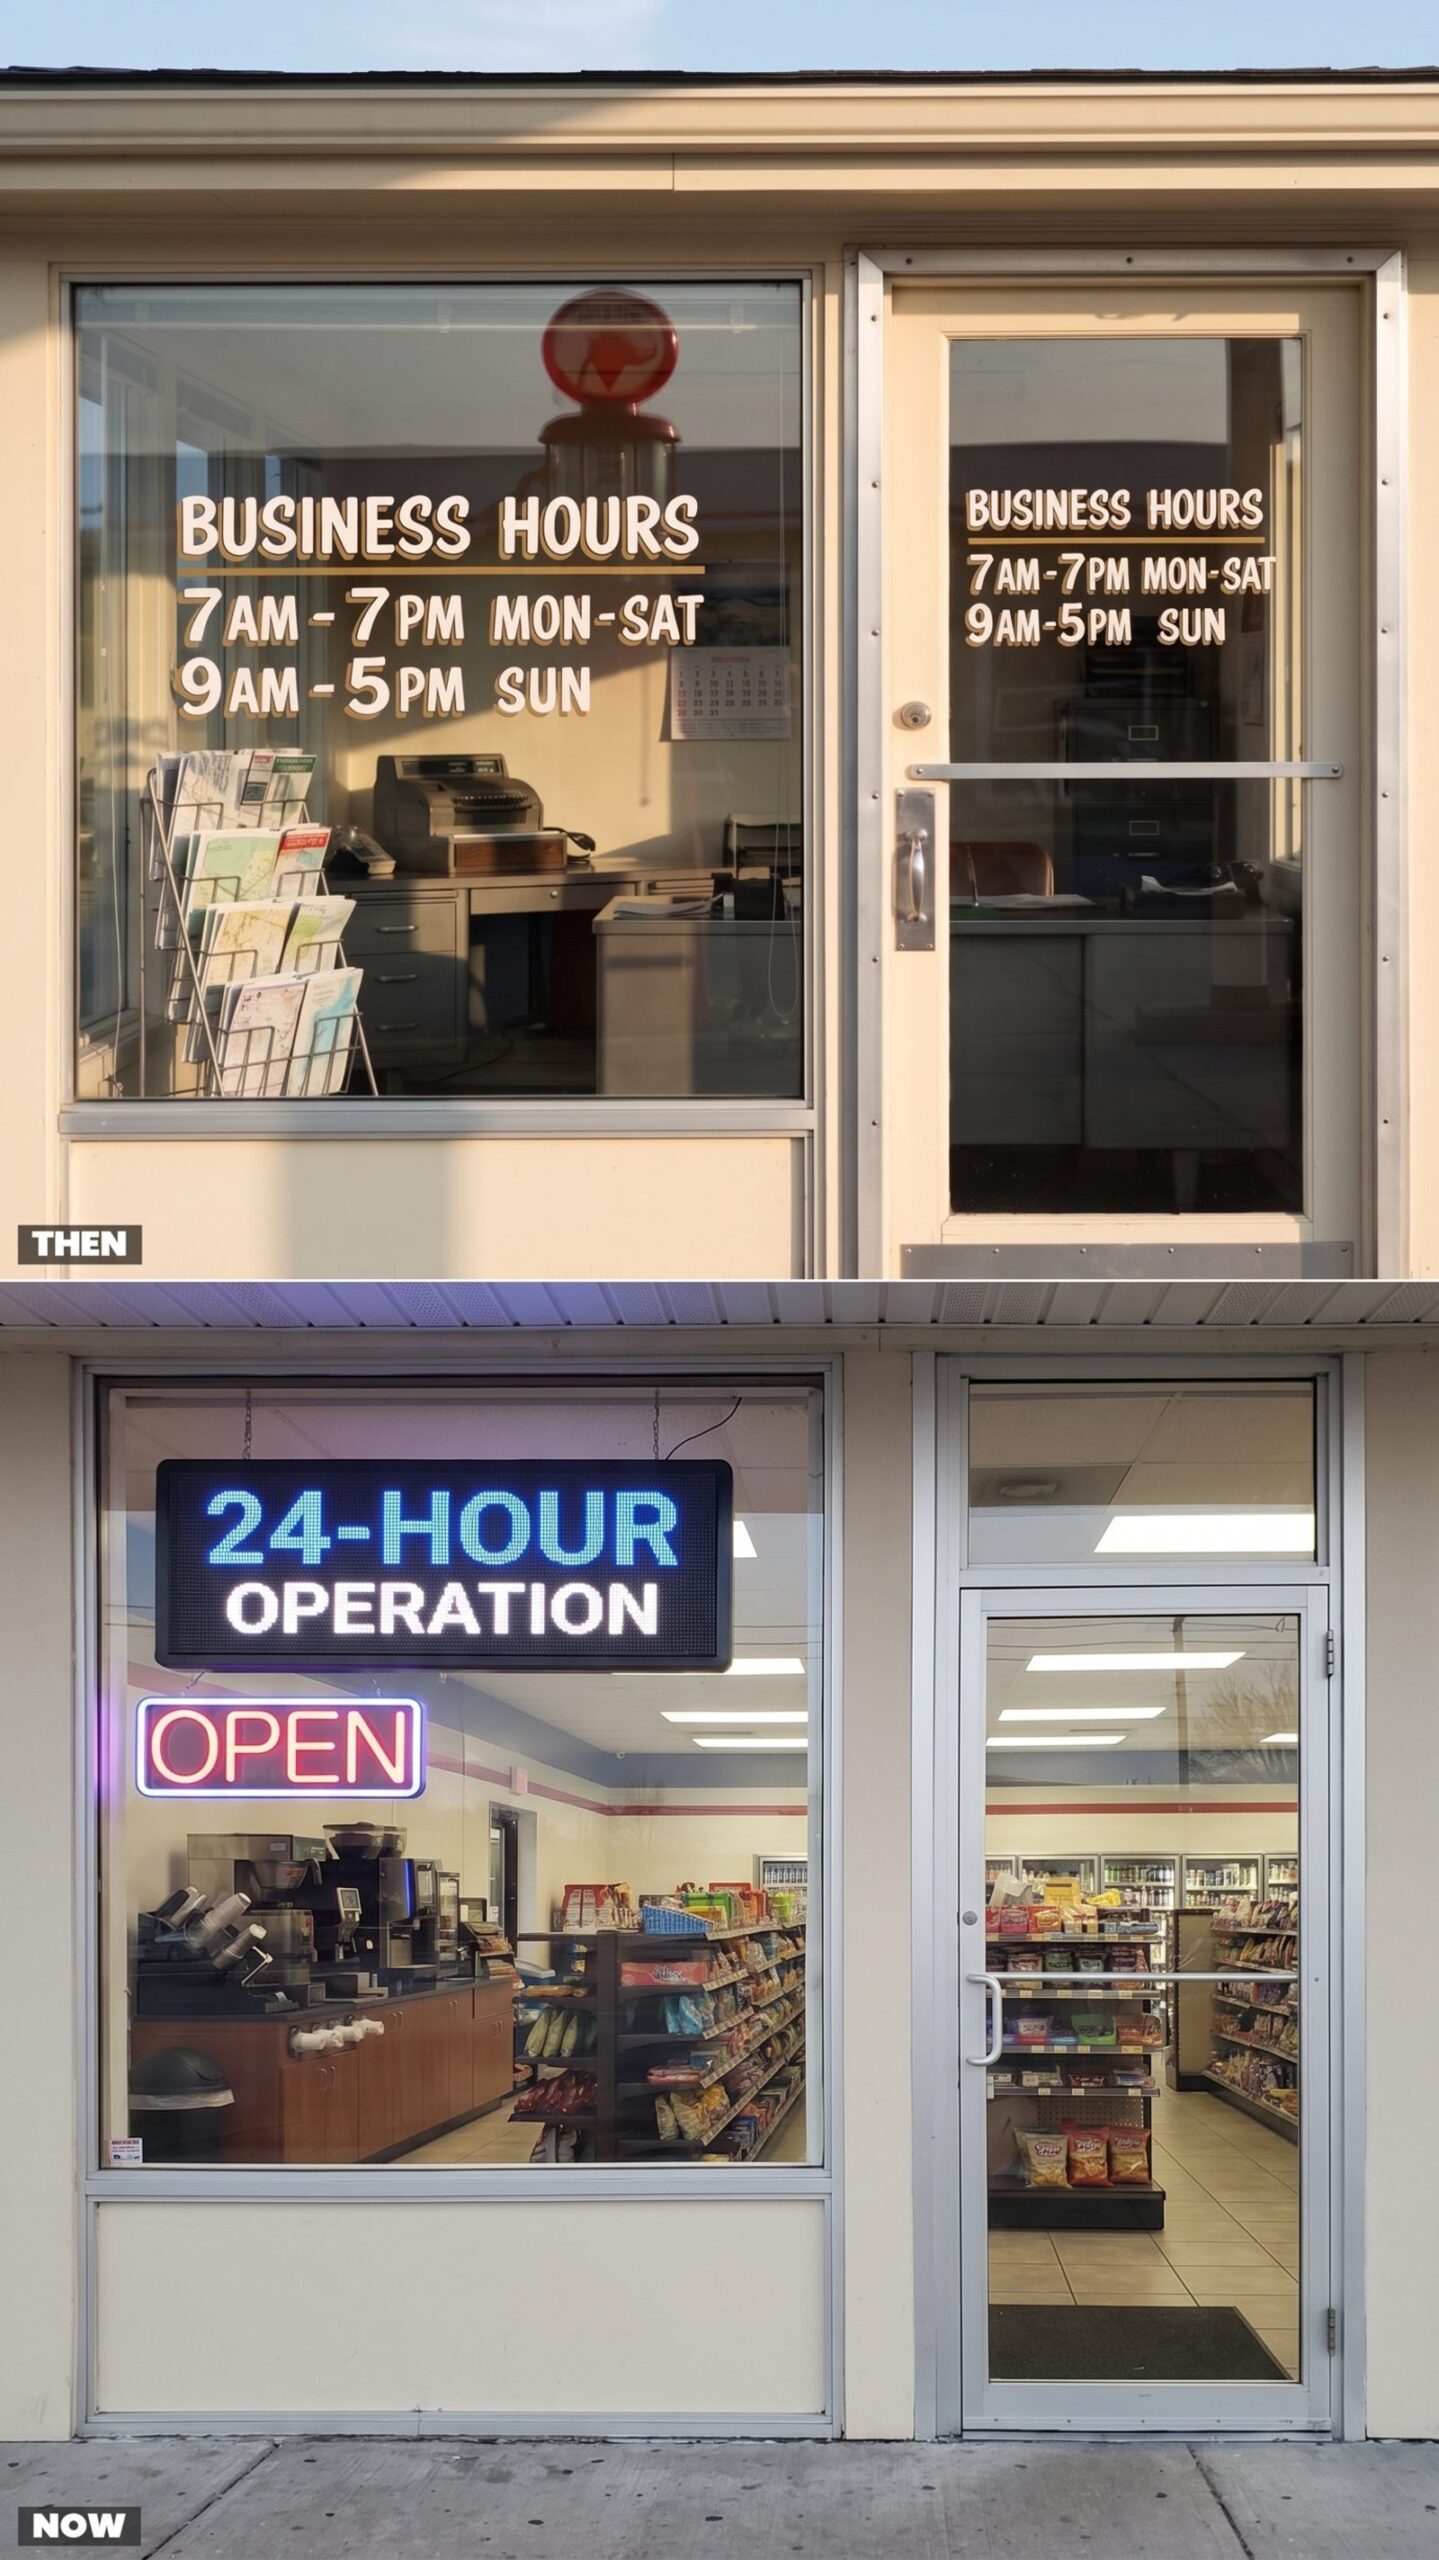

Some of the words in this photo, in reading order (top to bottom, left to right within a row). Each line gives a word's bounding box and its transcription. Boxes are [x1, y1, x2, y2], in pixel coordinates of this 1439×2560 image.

[179, 494, 470, 559] BUSINESS
[500, 494, 699, 559] HOURS
[966, 488, 1131, 530] BUSINESS
[1147, 488, 1263, 530] HOURS
[1142, 555, 1277, 595] MON-SAT
[490, 594, 705, 644] MON-SAT
[1157, 608, 1226, 647] SUN
[495, 666, 590, 718] SUN
[206, 1490, 679, 1566] 24-HOUR
[226, 1581, 658, 1635] OPERATION
[151, 1708, 406, 1785] OPEN
